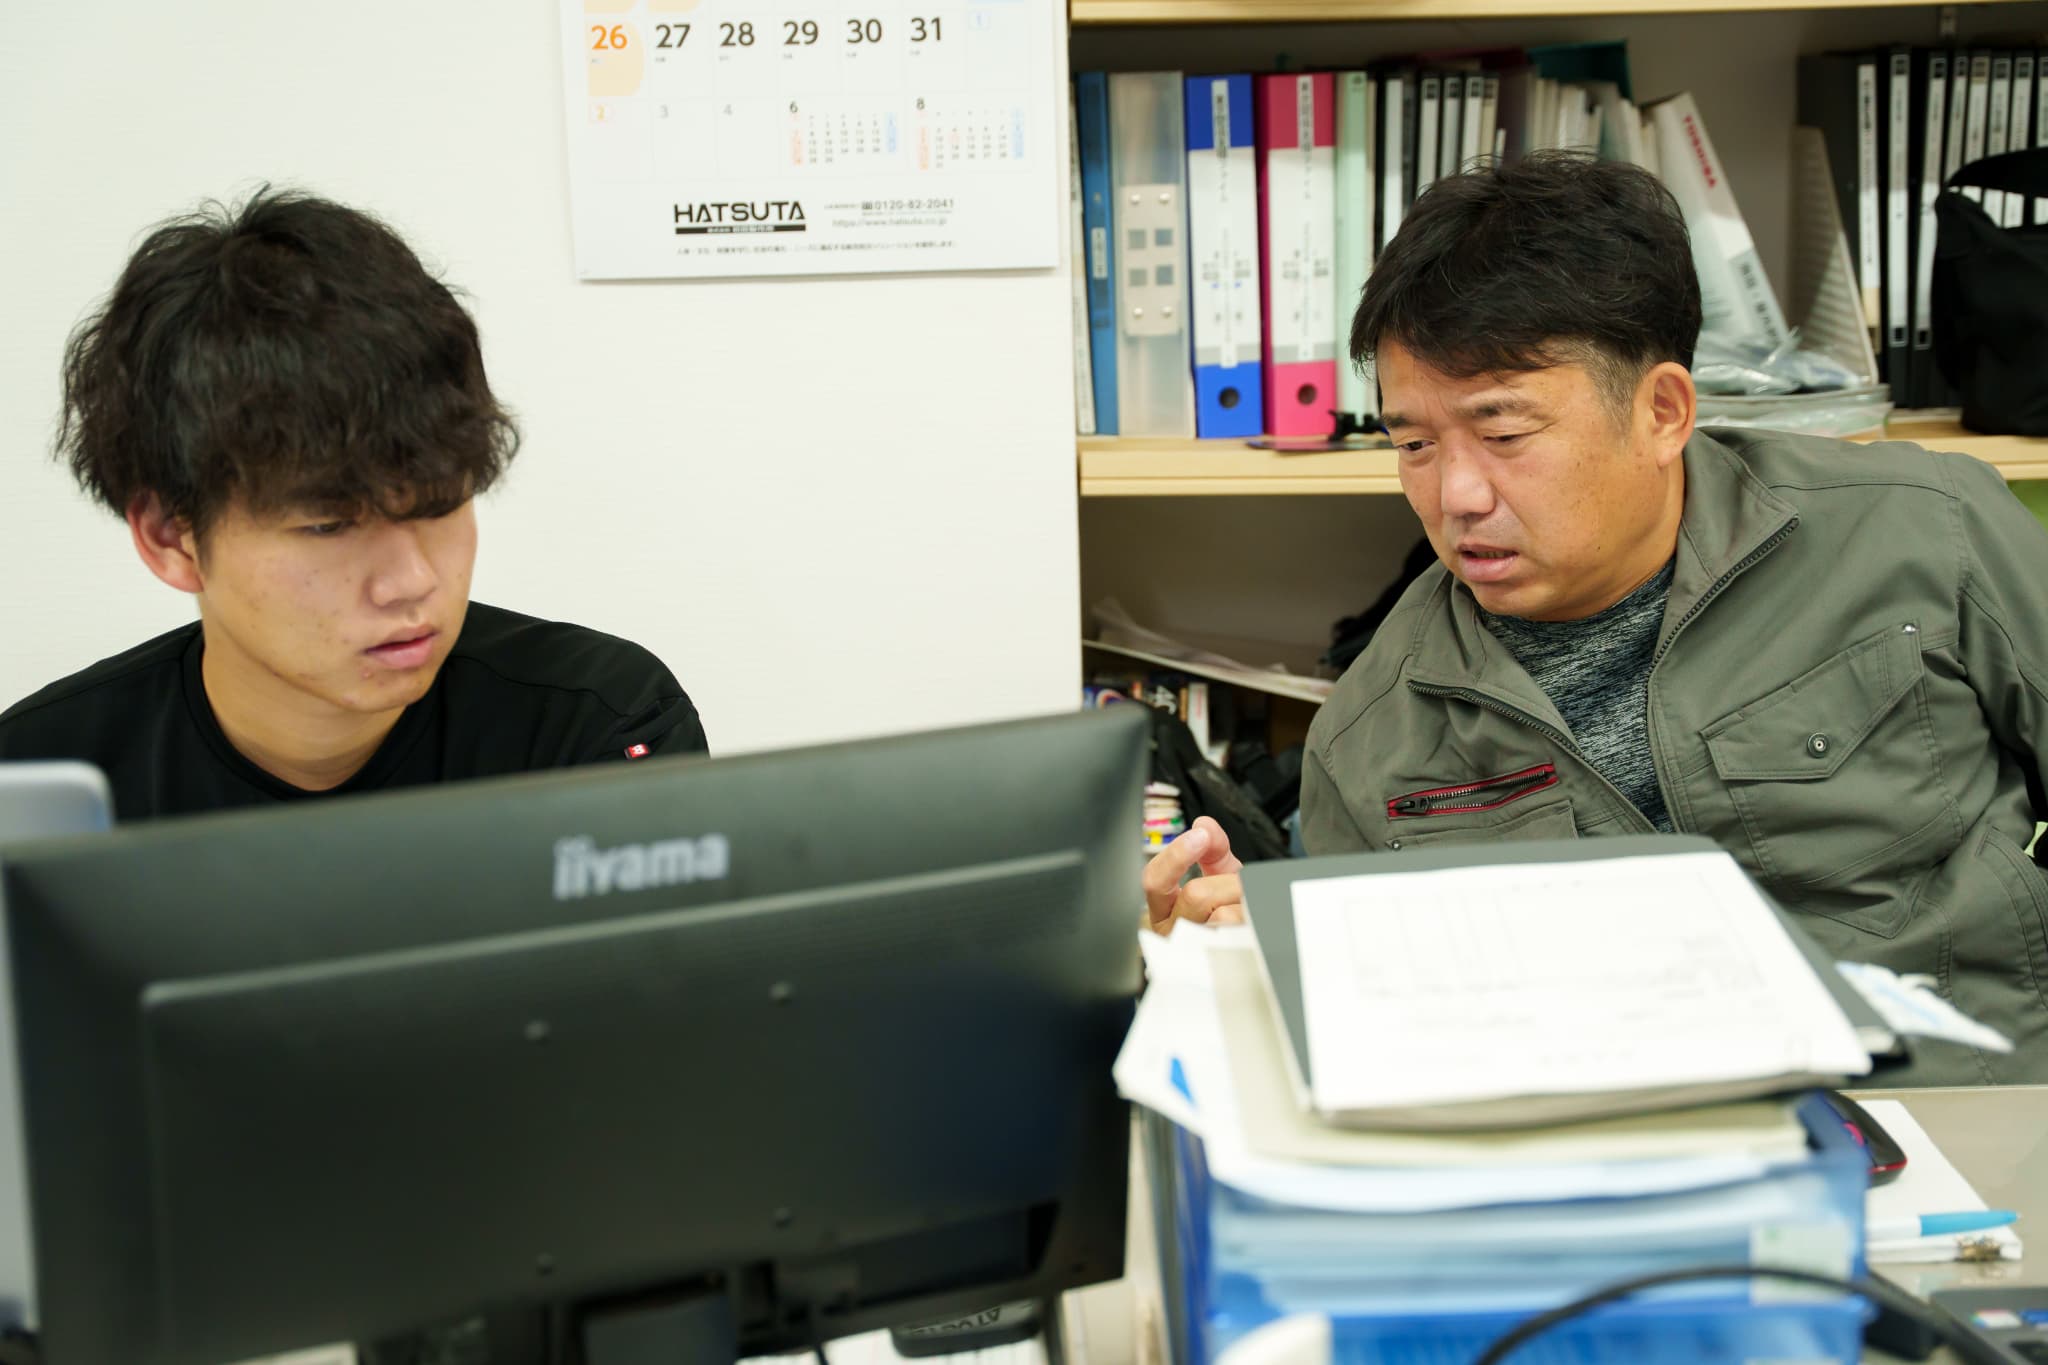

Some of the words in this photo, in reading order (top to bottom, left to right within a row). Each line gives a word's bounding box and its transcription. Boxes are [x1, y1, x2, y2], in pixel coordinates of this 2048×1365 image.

[591, 25, 628, 50] 26
[655, 24, 691, 49] 27
[719, 22, 755, 47] 28
[783, 21, 819, 46] 29
[847, 19, 883, 44] 30
[911, 17, 942, 42] 31
[659, 104, 669, 119] 3
[722, 103, 733, 116] 4
[789, 101, 799, 114] 6
[916, 97, 926, 111] 8
[674, 201, 806, 223] HATSUTA
